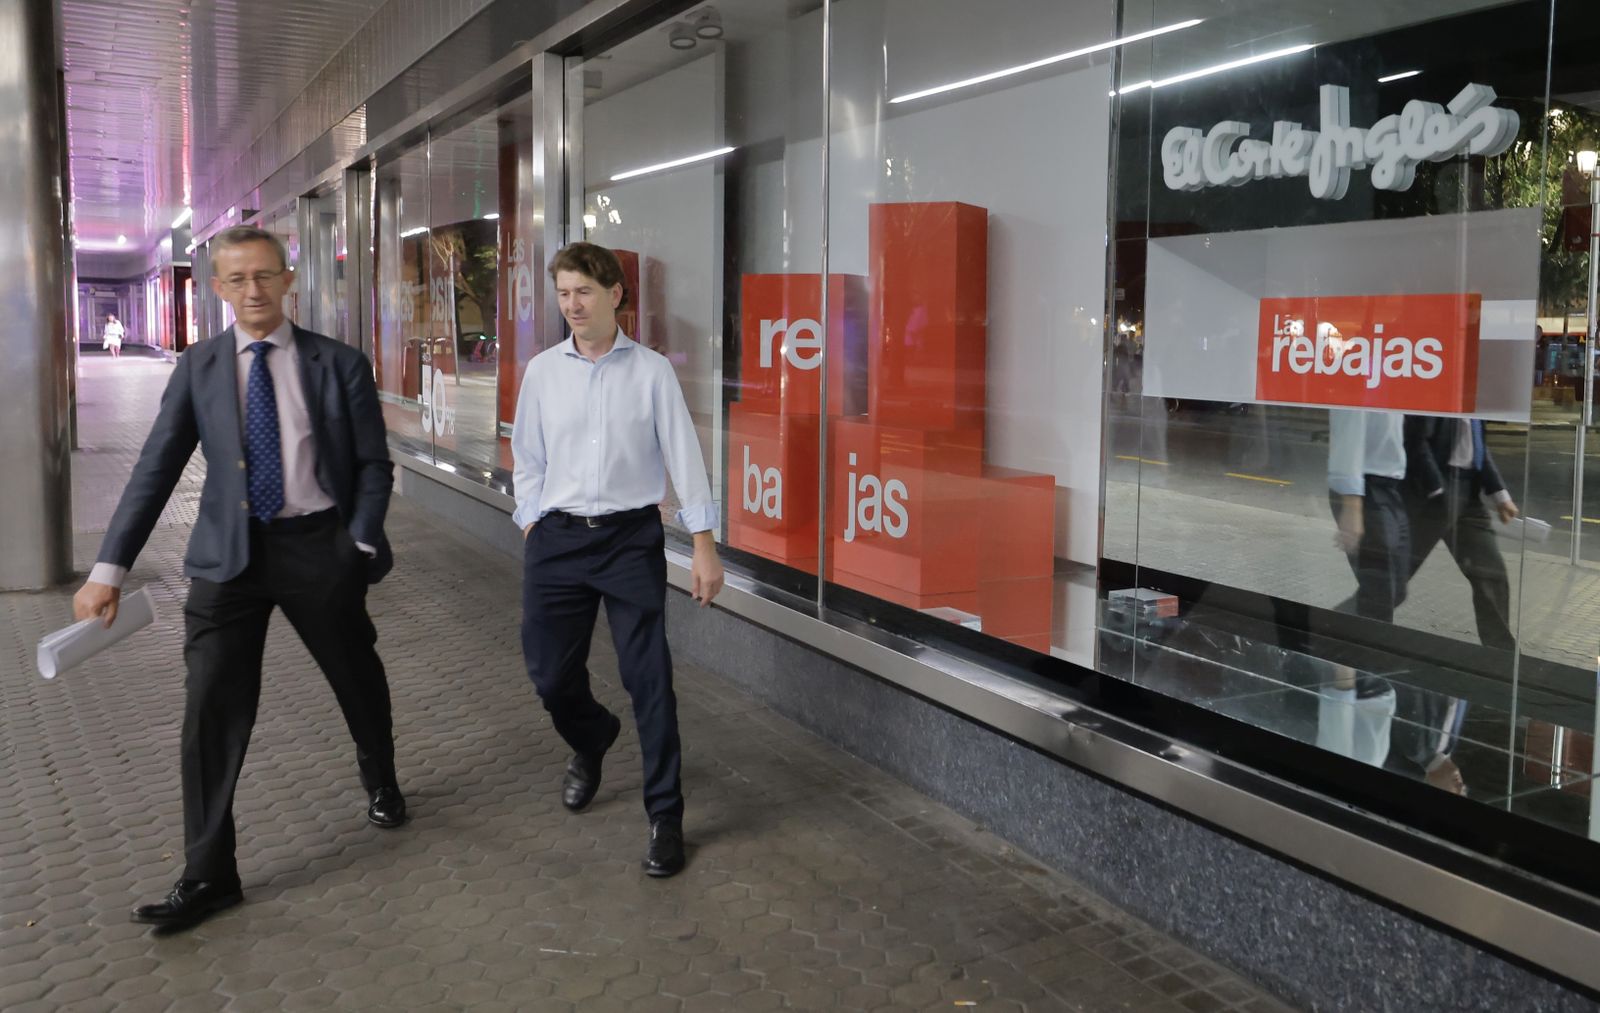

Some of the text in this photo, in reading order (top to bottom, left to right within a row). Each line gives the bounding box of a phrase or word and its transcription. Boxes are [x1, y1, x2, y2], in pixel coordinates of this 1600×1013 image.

[1161, 82, 1520, 200] El Corte Inglés
[759, 318, 823, 370] re
[1271, 323, 1444, 390] rebajas
[1273, 314, 1304, 336] Las
[743, 445, 782, 520] ba
[843, 452, 909, 543] jas
